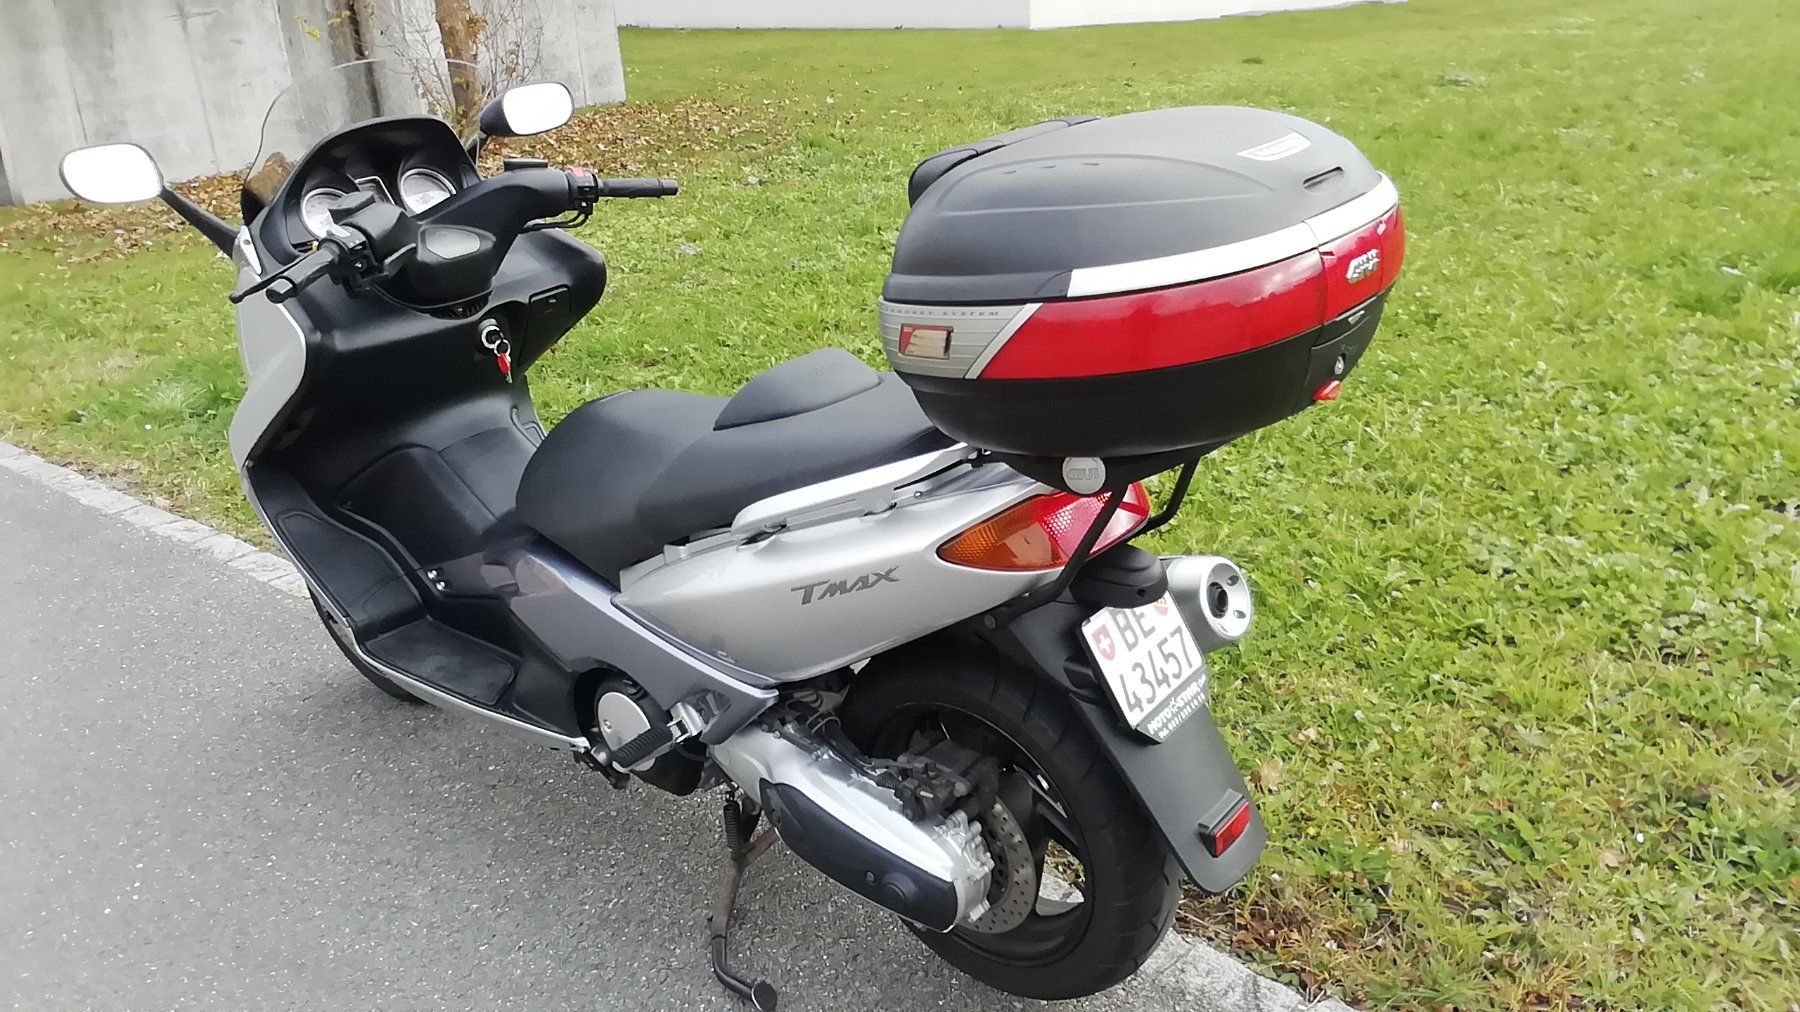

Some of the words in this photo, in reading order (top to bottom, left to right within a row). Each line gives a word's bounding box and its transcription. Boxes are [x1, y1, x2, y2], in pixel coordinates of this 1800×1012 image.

[791, 565, 900, 605] TMAX
[1109, 608, 1156, 652] BE
[1119, 625, 1193, 713] 43457
